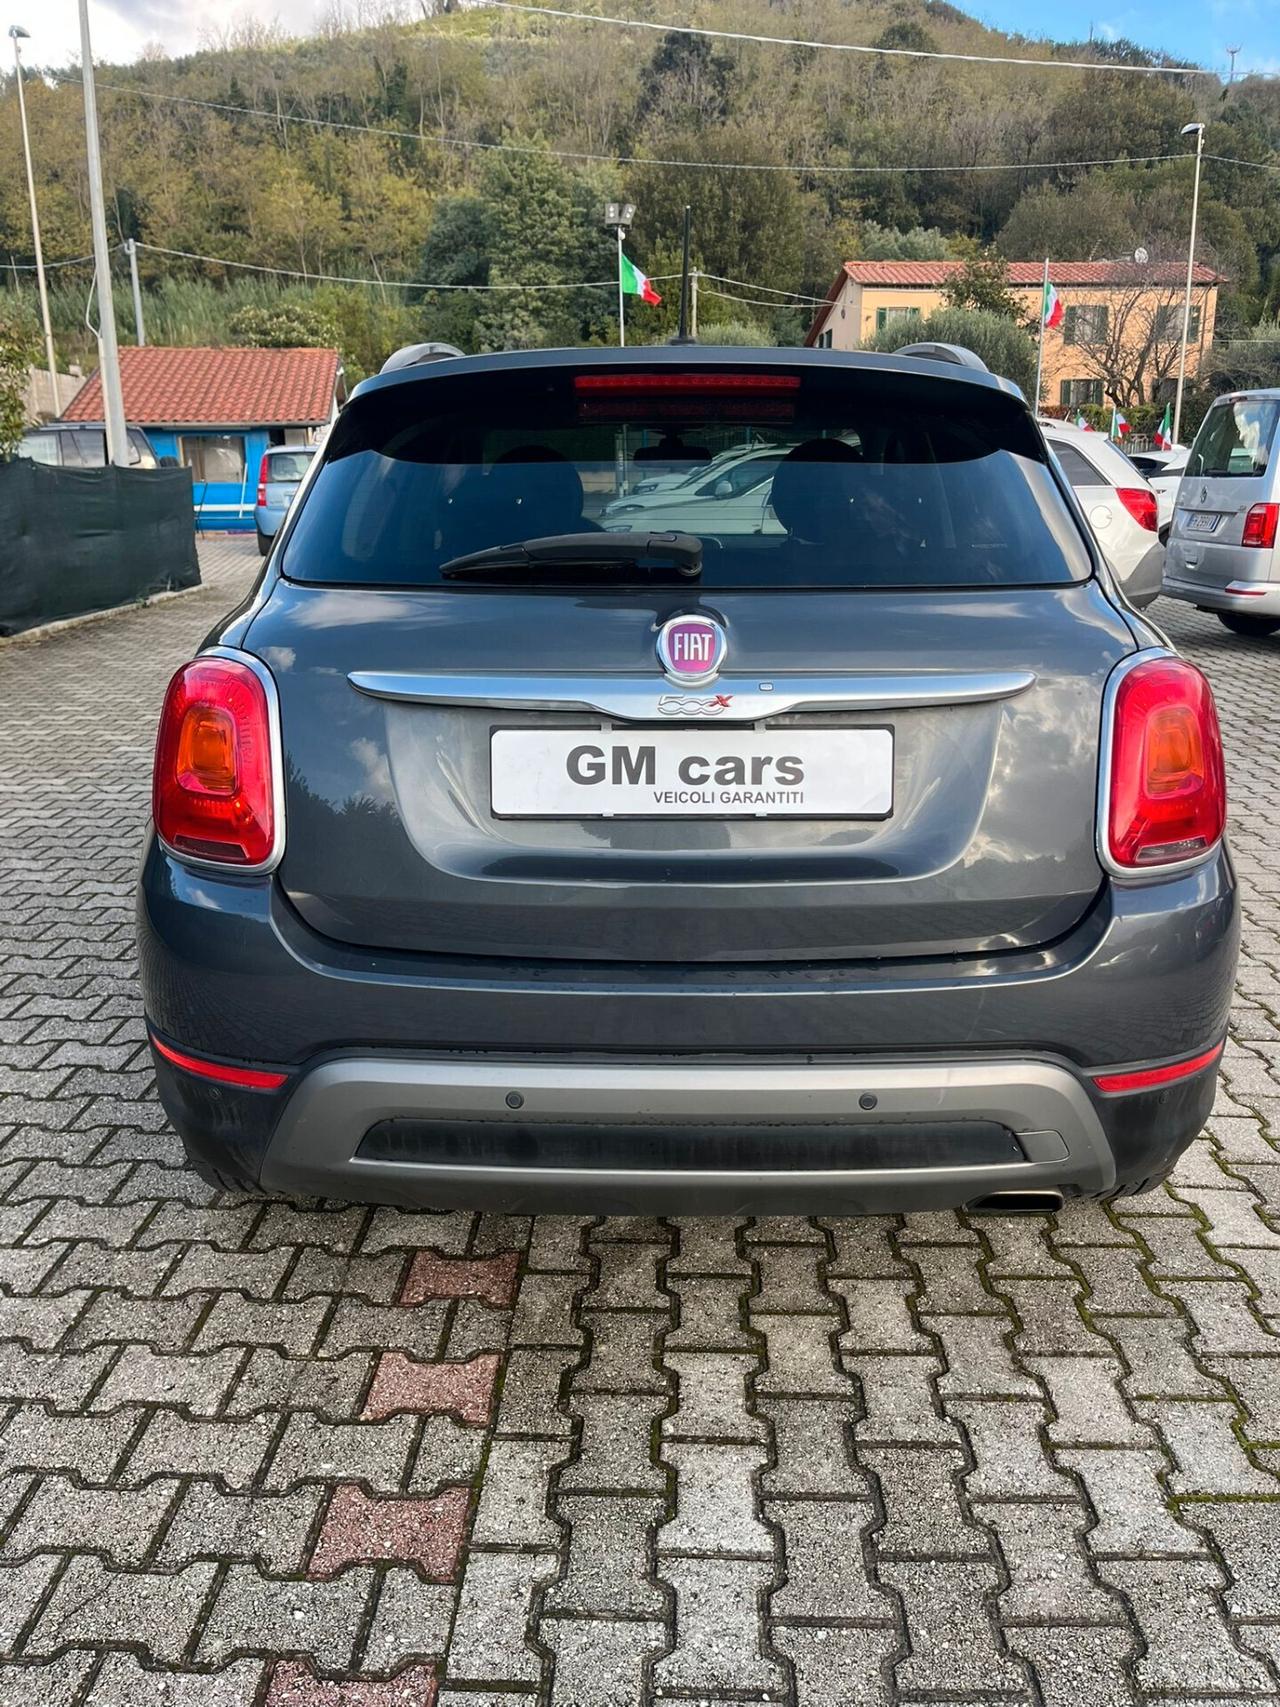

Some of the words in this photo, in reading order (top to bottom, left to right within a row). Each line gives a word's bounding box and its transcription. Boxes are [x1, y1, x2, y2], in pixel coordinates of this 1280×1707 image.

[673, 632, 713, 661] FIAT
[566, 745, 656, 786] GM
[678, 755, 805, 786] cars
[653, 791, 715, 804] VEICOLI
[719, 791, 804, 804] GARANTITI
